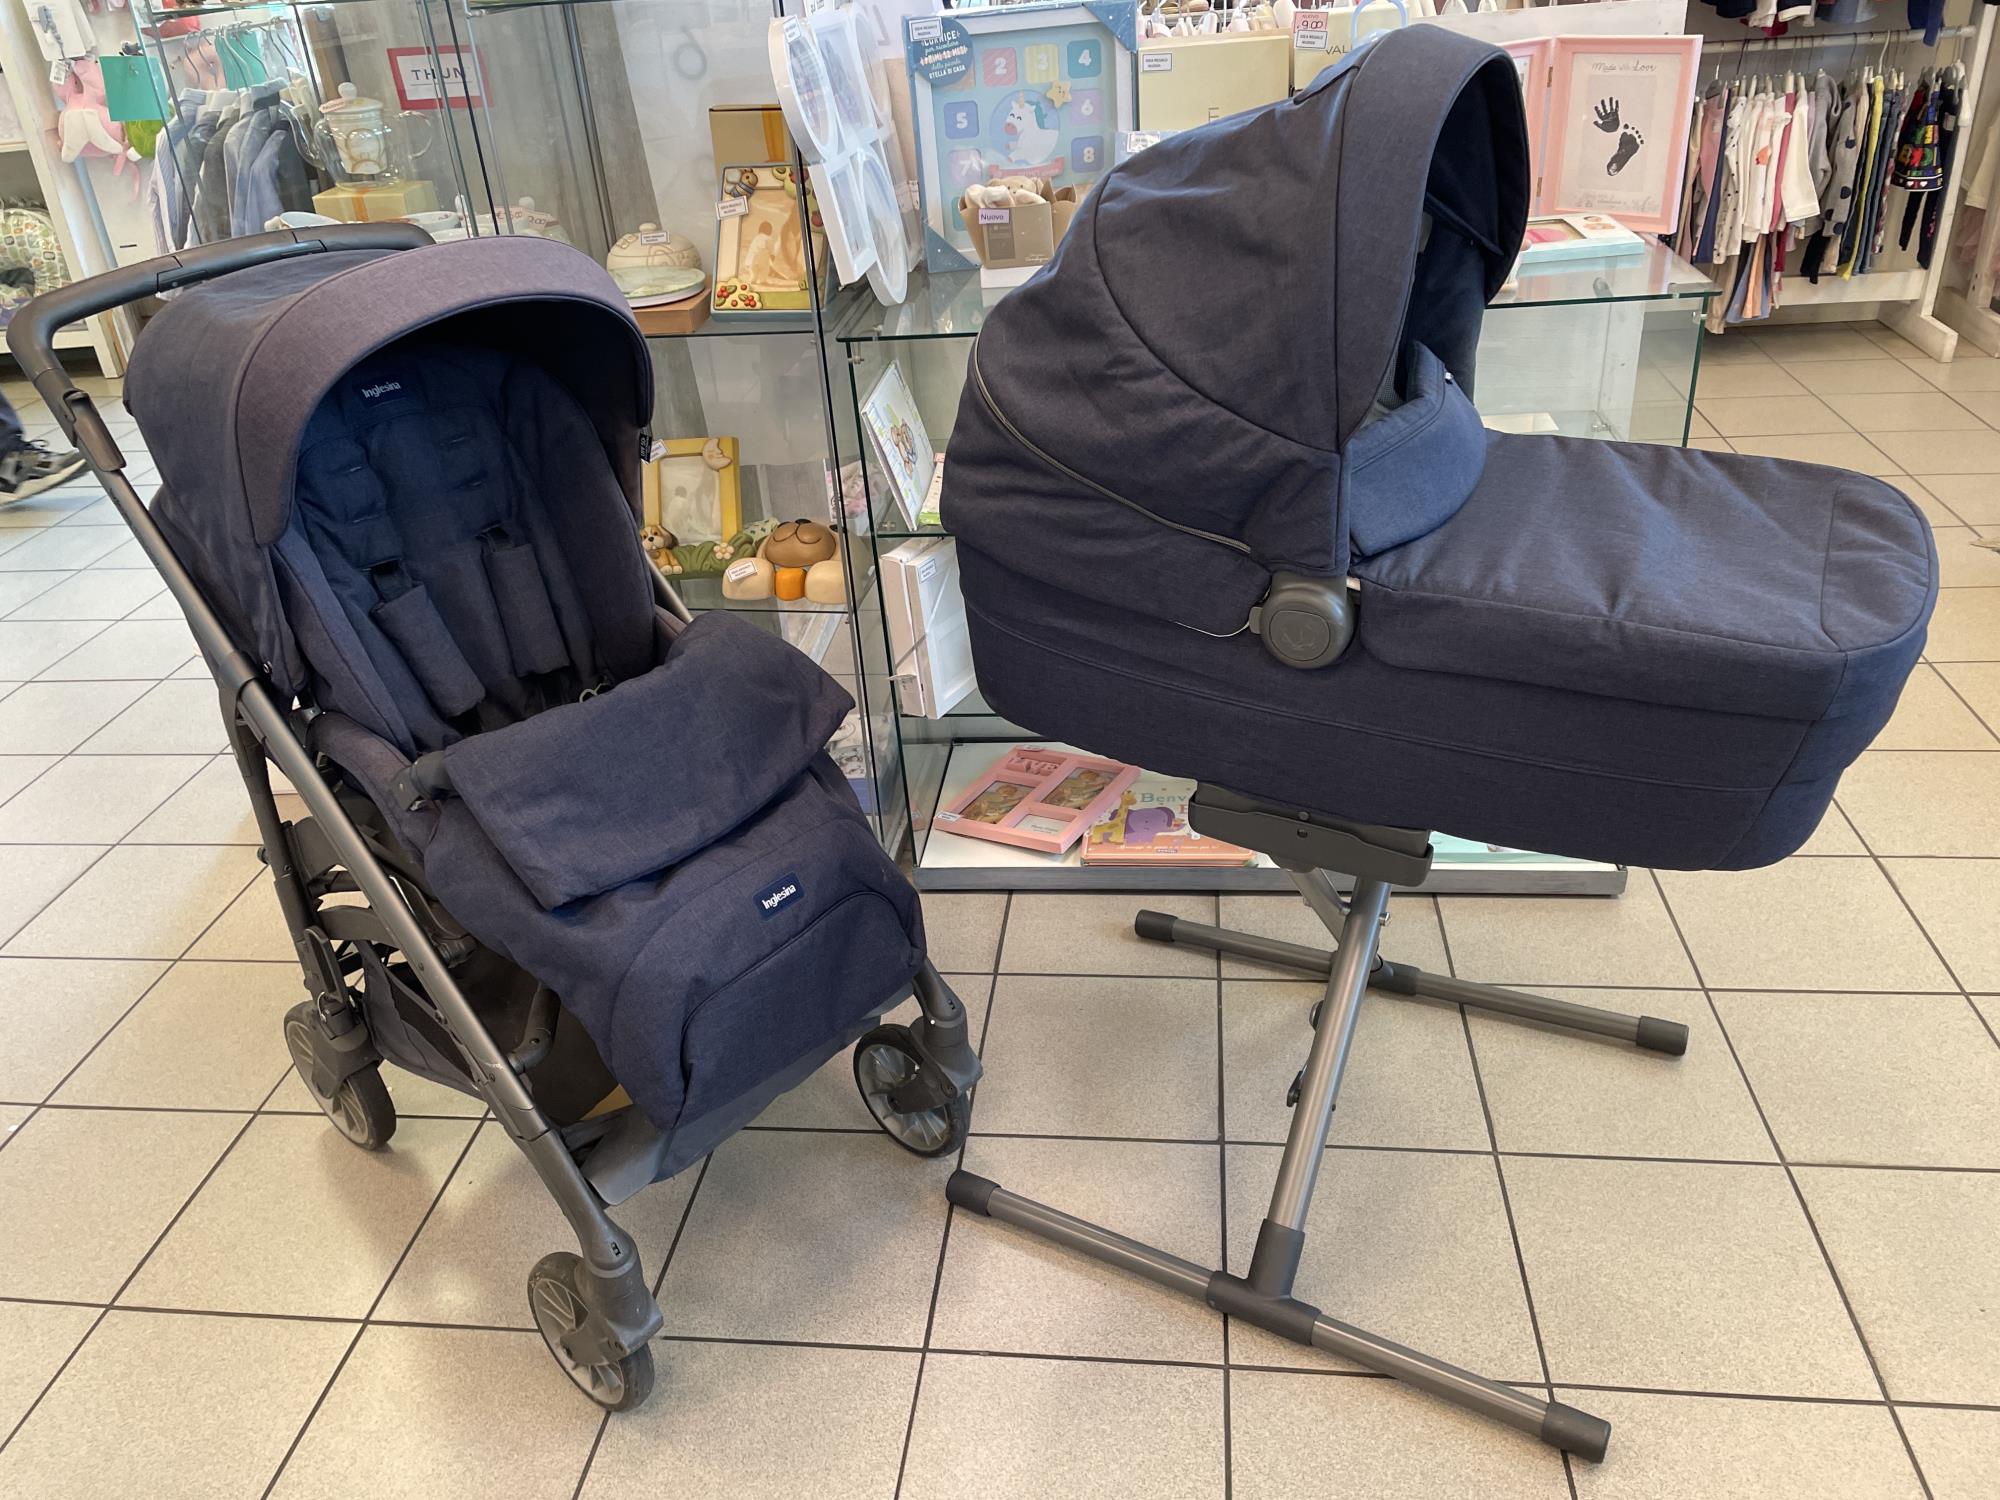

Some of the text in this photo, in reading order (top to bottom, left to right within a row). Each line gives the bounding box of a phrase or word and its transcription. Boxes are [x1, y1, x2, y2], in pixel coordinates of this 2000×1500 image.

[1078, 49, 1092, 66] 4
[1326, 45, 1353, 55] VAL
[994, 57, 1008, 75] 2
[1037, 52, 1049, 71] 3
[1632, 59, 1657, 72] Love
[410, 67, 463, 80] THUN
[929, 69, 947, 79] STELLA
[1081, 99, 1094, 116] 6
[956, 112, 969, 129] 5
[1083, 146, 1096, 164] 8
[361, 381, 401, 398] Inglesina
[1140, 792, 1188, 803] Benv
[761, 884, 797, 909] Inglesina
